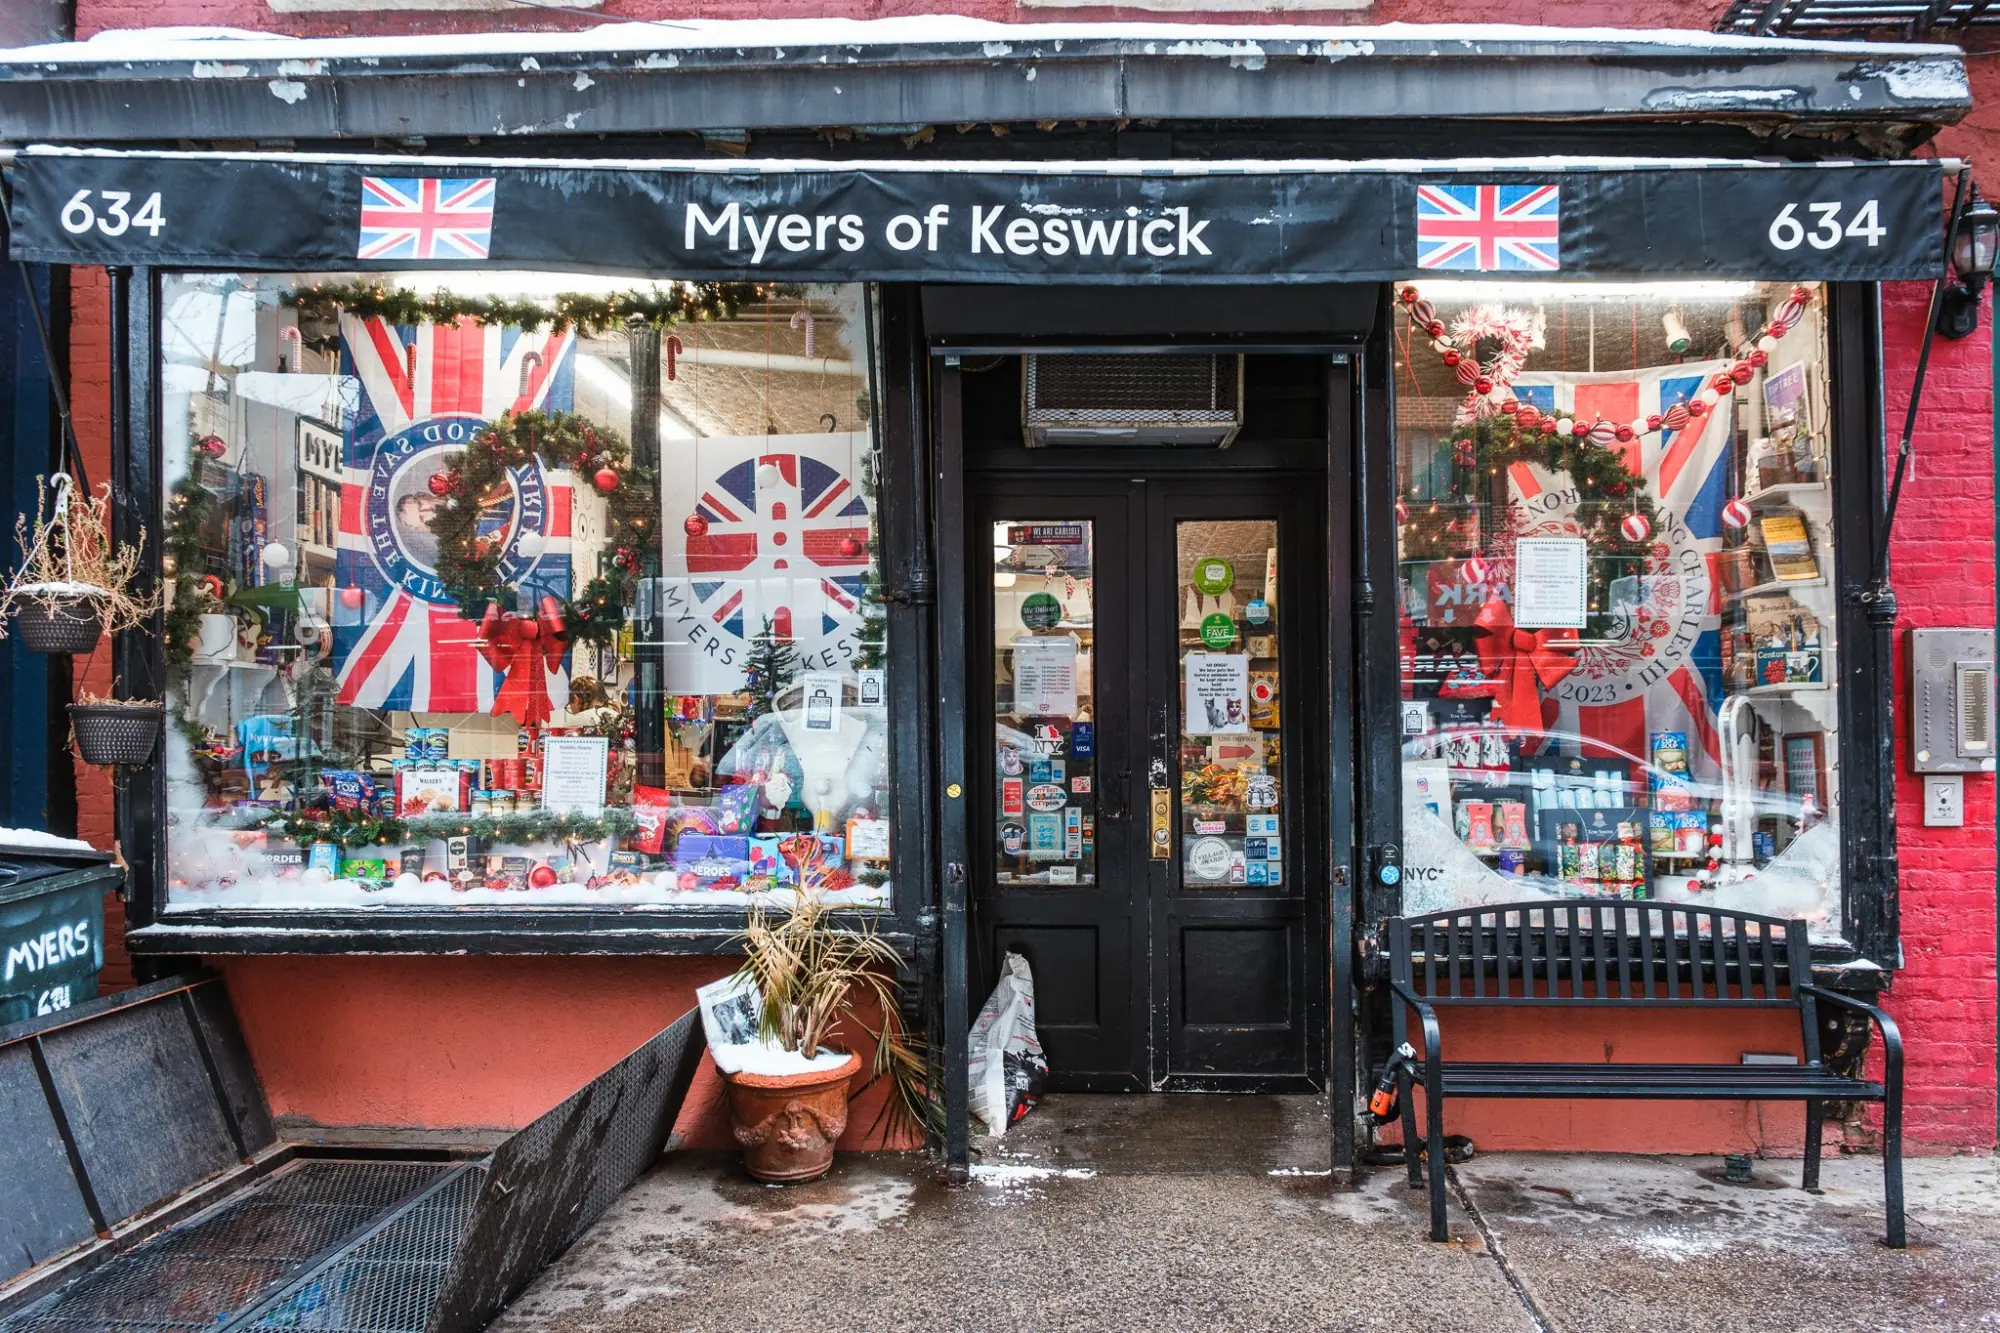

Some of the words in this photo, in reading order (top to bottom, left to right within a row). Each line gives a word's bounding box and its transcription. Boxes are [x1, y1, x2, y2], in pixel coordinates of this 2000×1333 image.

[61, 189, 166, 237] 634
[1769, 200, 1887, 250] 634
[684, 202, 865, 264] Myers
[886, 204, 949, 252] of
[971, 205, 1213, 256] Keswick
[1767, 373, 1798, 396] TIPTREE
[1032, 527, 1042, 536] WE
[1042, 527, 1053, 536] ARE
[1054, 527, 1081, 536] CARLISLE
[1664, 548, 1704, 662] CHARLES
[663, 585, 736, 666] MYERS
[1206, 628, 1229, 637] FAVE
[801, 627, 866, 671] KES
[1561, 683, 1617, 703] 2023
[1036, 725, 1044, 739] I
[690, 865, 732, 877] HEROES
[1198, 849, 1224, 860] VILLAGE
[5, 918, 90, 982] MYERS
